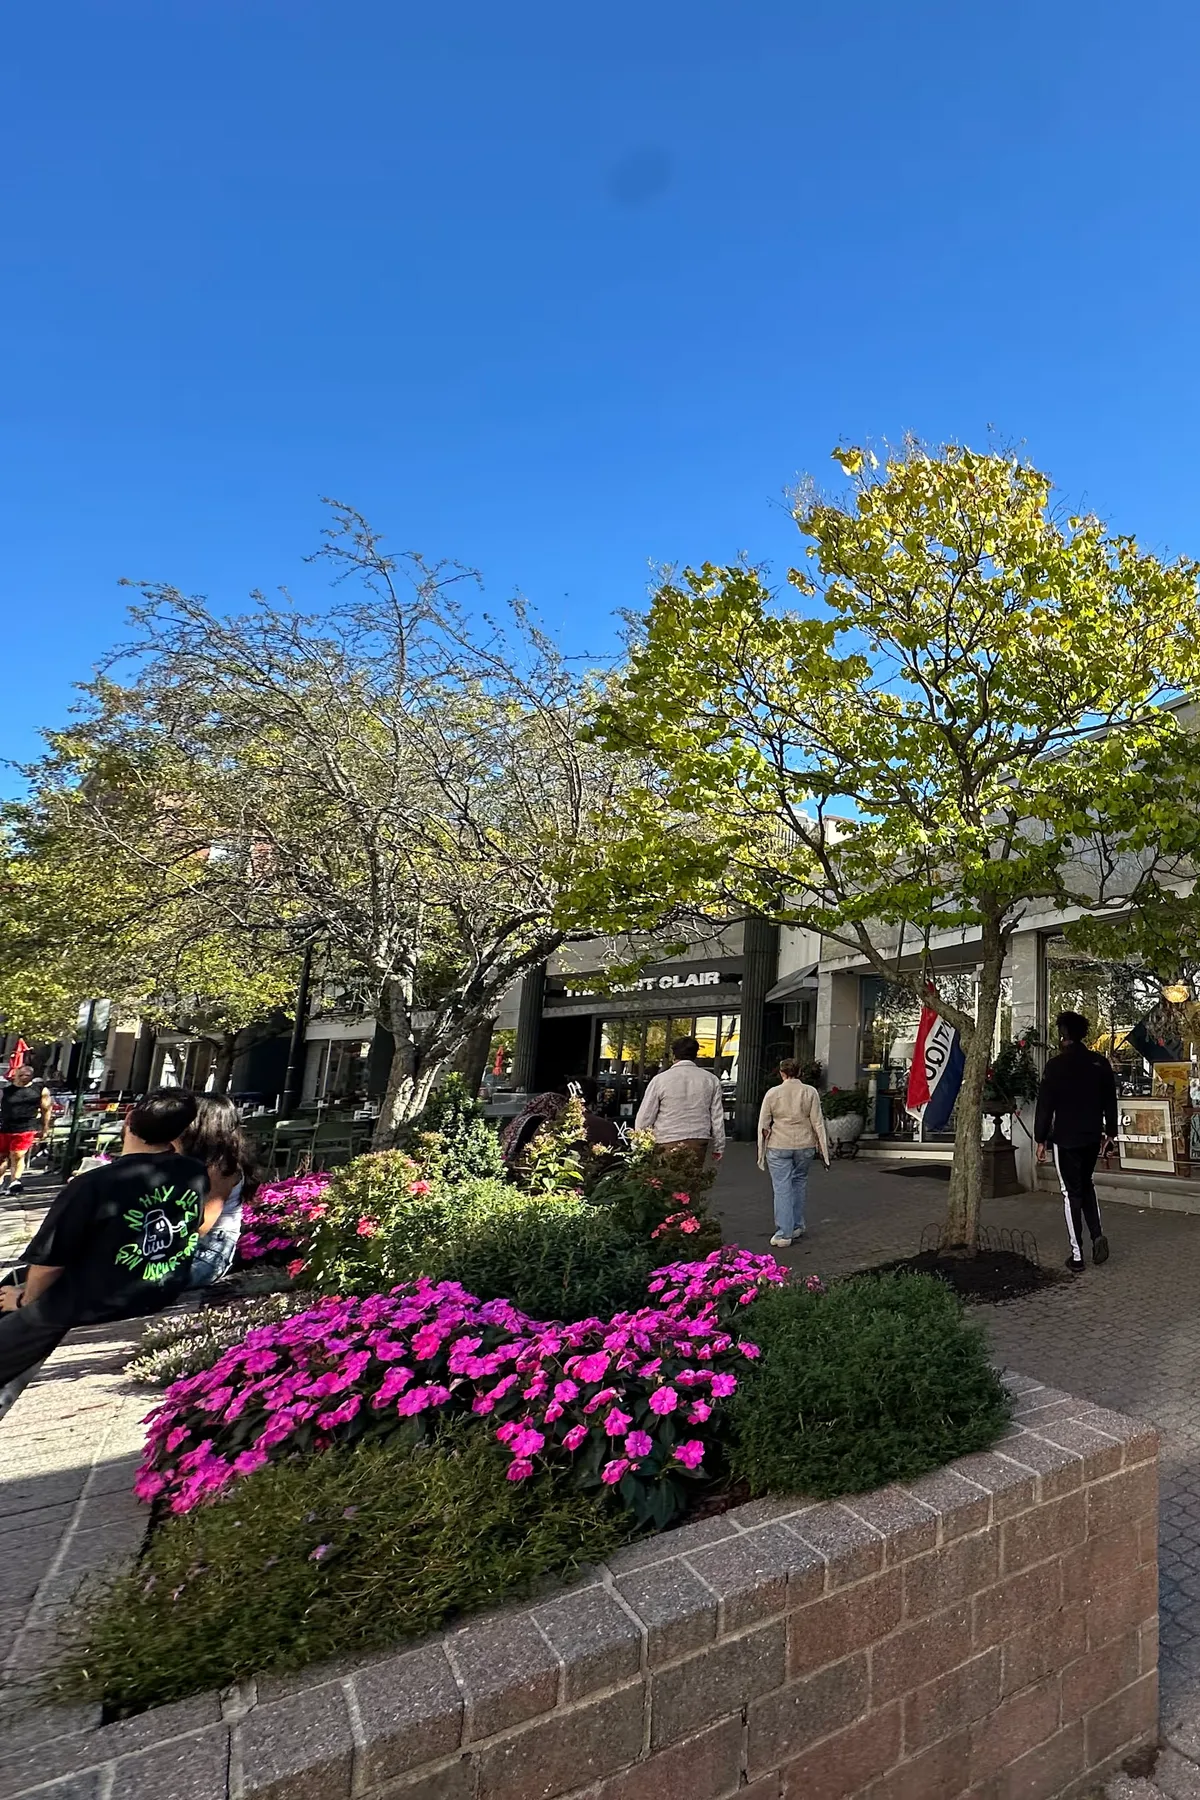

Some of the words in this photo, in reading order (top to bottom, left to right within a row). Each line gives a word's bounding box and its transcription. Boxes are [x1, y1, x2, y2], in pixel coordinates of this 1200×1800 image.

[658, 971, 722, 990] CLAIR
[1116, 1134, 1163, 1145] ENTER
[123, 1209, 144, 1232] NO
[139, 1185, 175, 1208] HAY
